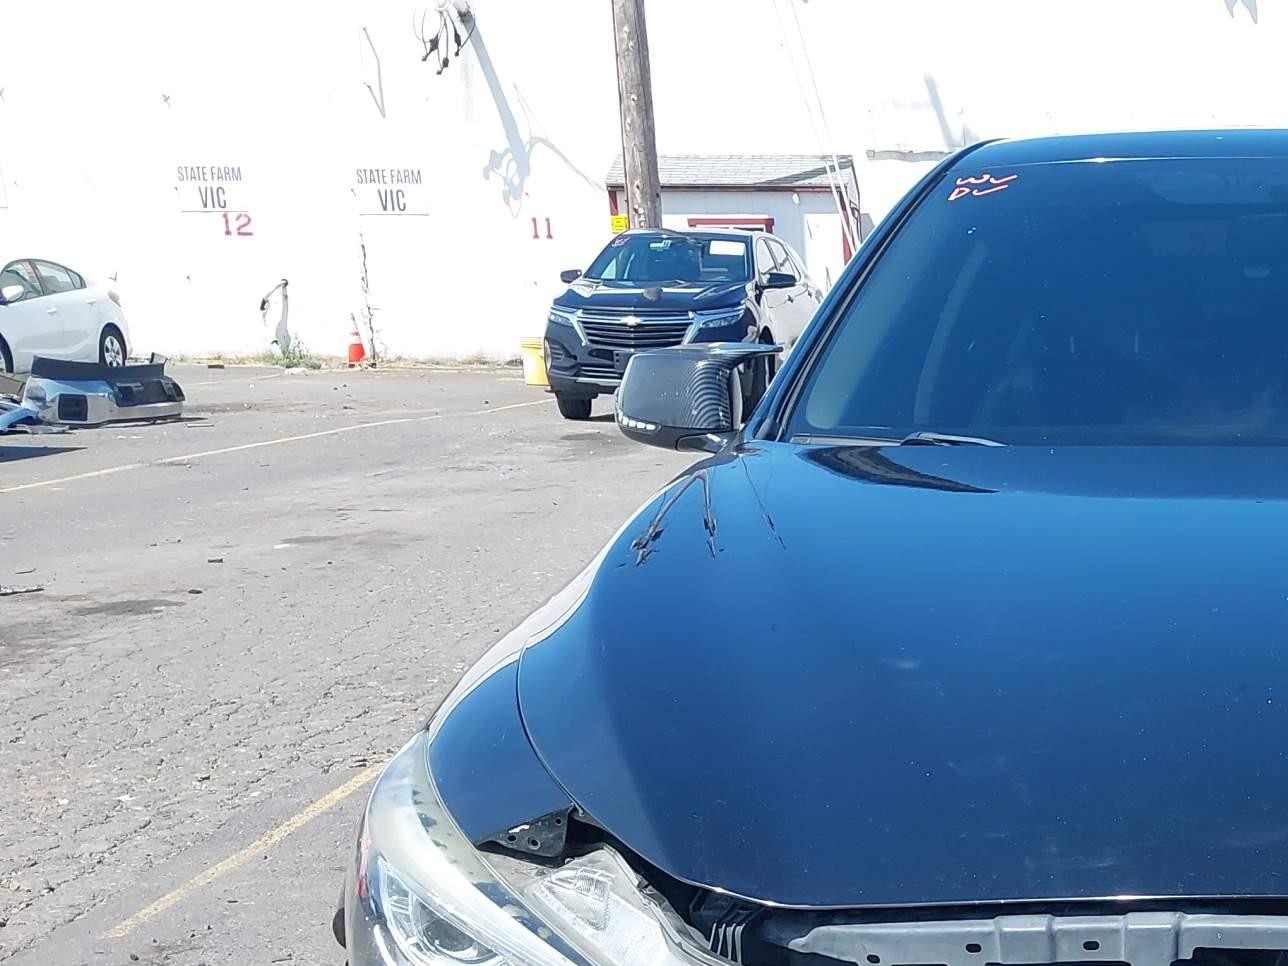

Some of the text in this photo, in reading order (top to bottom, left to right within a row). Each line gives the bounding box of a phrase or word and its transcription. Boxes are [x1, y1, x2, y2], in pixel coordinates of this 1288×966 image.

[178, 166, 242, 181] STATE FARM
[356, 168, 422, 184] STATE FARM
[198, 186, 226, 208] VIC
[377, 189, 406, 211] VIC
[222, 213, 253, 236] 12
[531, 217, 553, 239] 11
